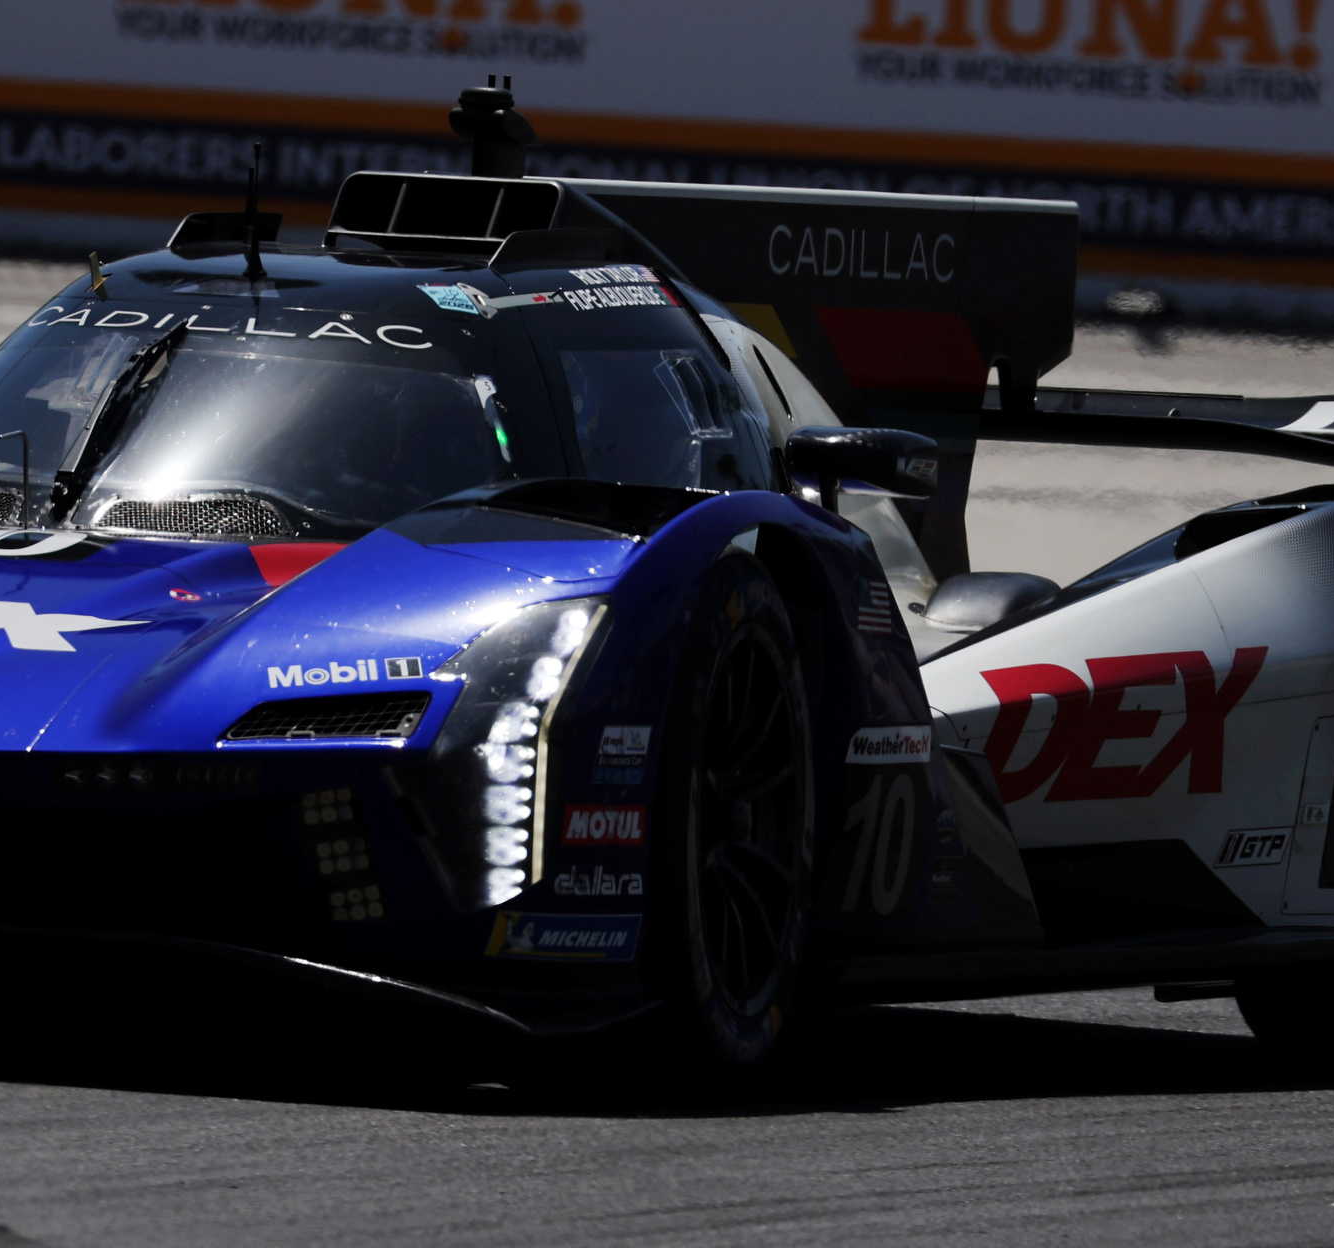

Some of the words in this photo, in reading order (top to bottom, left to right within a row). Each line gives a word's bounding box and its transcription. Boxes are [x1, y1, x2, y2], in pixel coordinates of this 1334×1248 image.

[767, 223, 956, 284] CADILLAC
[27, 304, 434, 351] CADILLAC
[267, 658, 379, 689] Mobil
[979, 646, 1269, 804] DEX
[852, 732, 929, 755] WeatherTech
[565, 810, 641, 840] MOTUL
[839, 772, 916, 917] 10
[1239, 834, 1286, 859] GTP
[553, 865, 643, 896] dallara
[537, 930, 628, 948] MICHELIN
